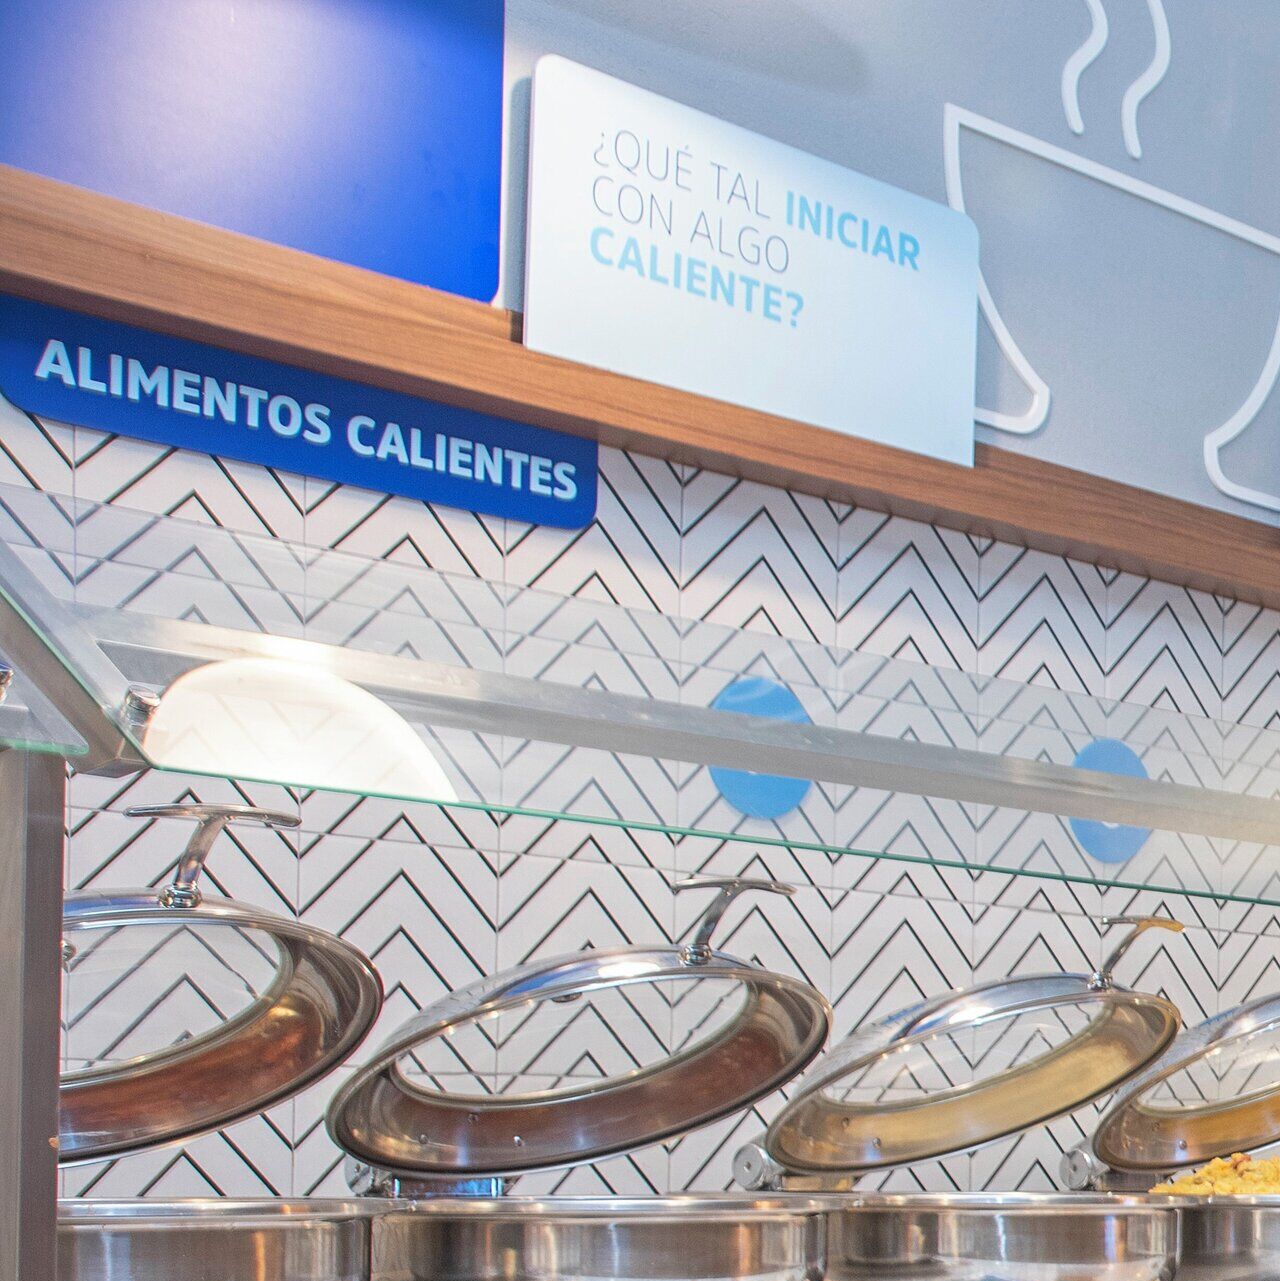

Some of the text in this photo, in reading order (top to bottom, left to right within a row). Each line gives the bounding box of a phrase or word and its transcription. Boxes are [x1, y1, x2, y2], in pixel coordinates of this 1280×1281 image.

[592, 175, 790, 274] CON ALGO
[593, 130, 921, 271] ¿QUÉ TAL INICIAR
[589, 226, 805, 328] CALIENTE?
[34, 339, 578, 502] ALIMENTOS CALIENTES
